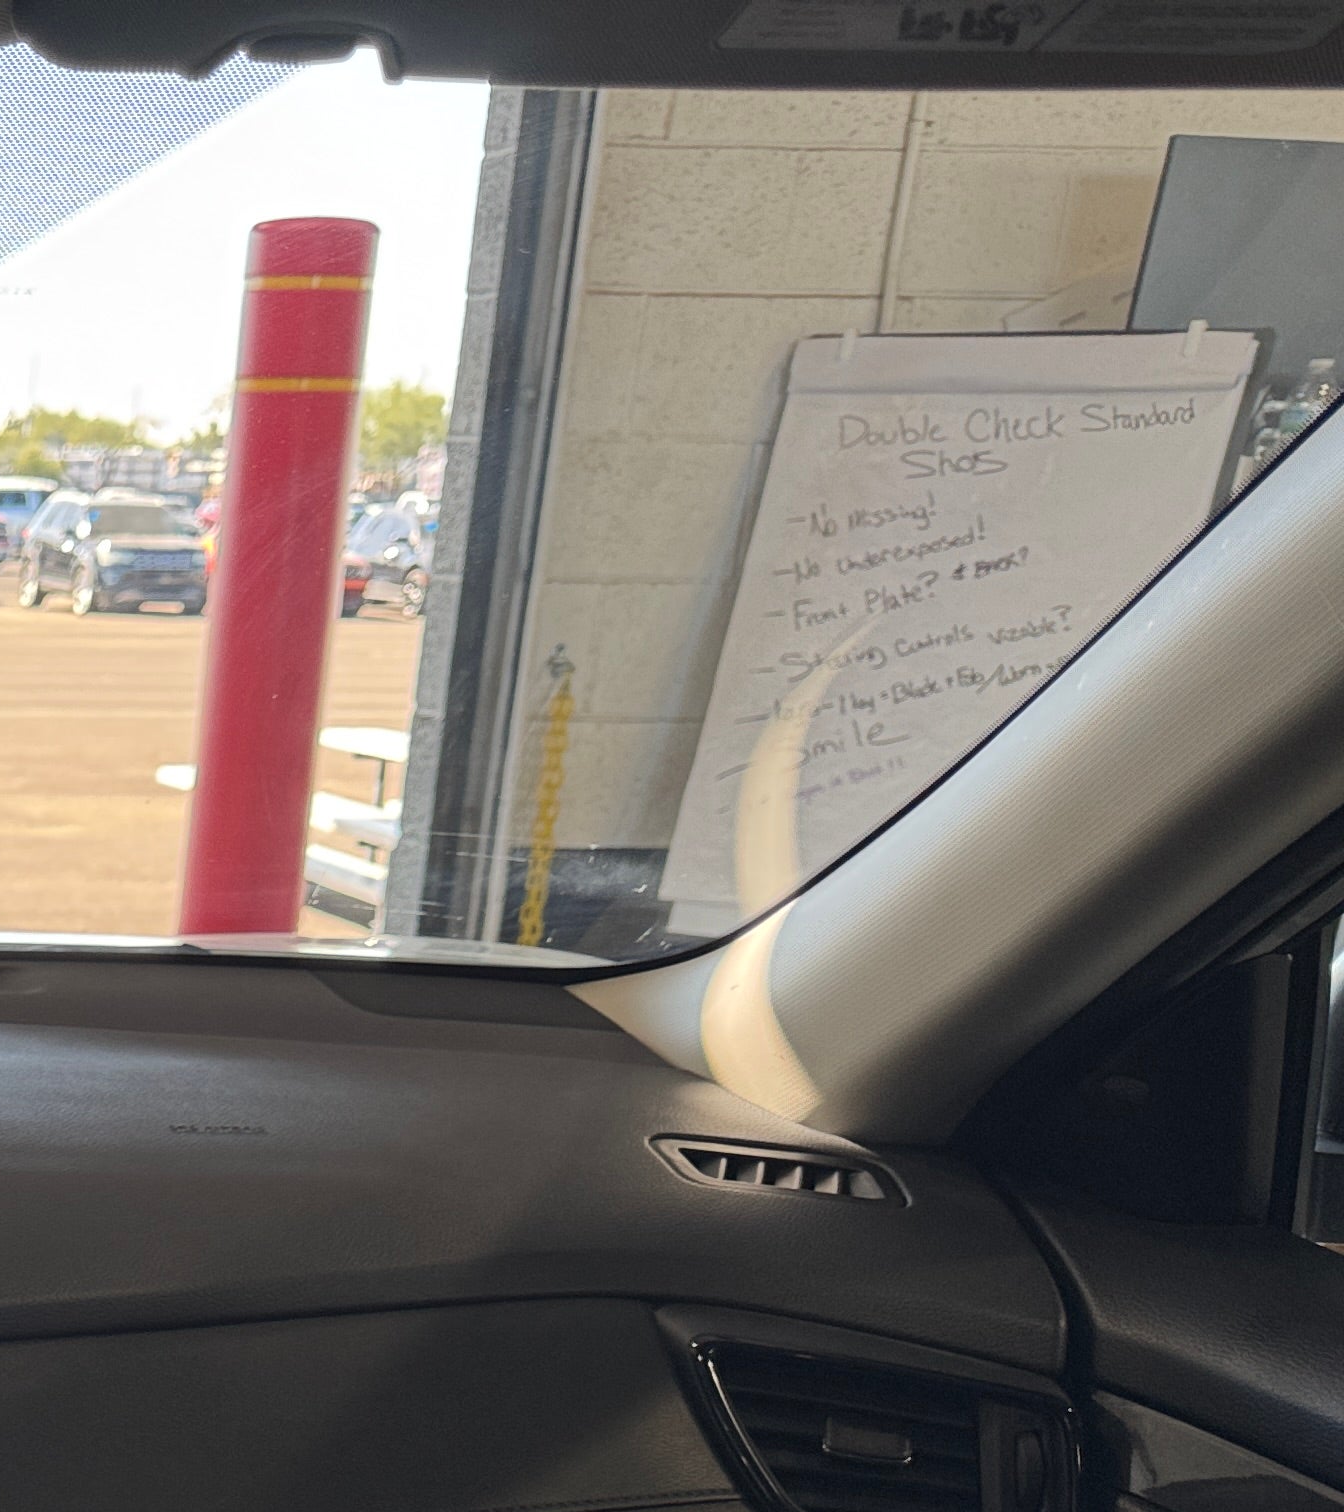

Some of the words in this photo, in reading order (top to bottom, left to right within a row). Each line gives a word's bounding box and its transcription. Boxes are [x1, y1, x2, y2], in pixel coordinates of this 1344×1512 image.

[839, 414, 948, 450] Double
[965, 406, 1065, 443] Check
[1081, 398, 1196, 432] Standard
[811, 502, 837, 537] No
[794, 556, 820, 584] No
[793, 597, 849, 631] Front
[864, 570, 939, 614] Plate?
